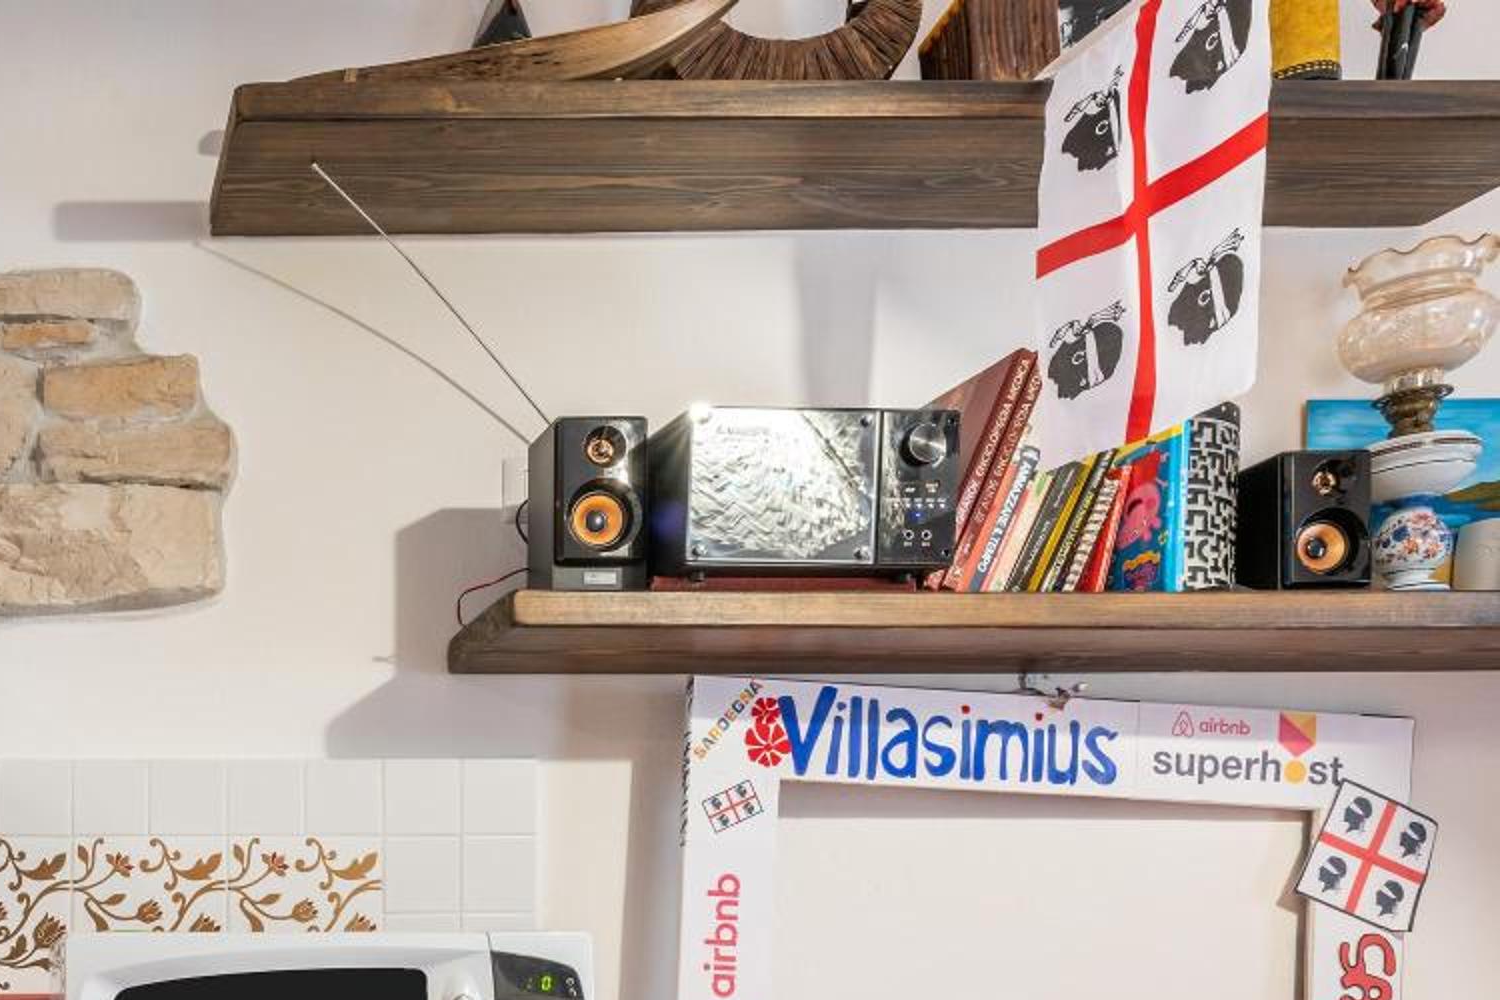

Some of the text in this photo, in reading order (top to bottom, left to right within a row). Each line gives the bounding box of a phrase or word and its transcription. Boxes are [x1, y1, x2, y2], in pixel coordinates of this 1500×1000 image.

[779, 685, 1119, 786] Villasimius
[1199, 717, 1251, 736] airbnb
[1153, 750, 1344, 786] superhost
[703, 872, 742, 998] airbnb
